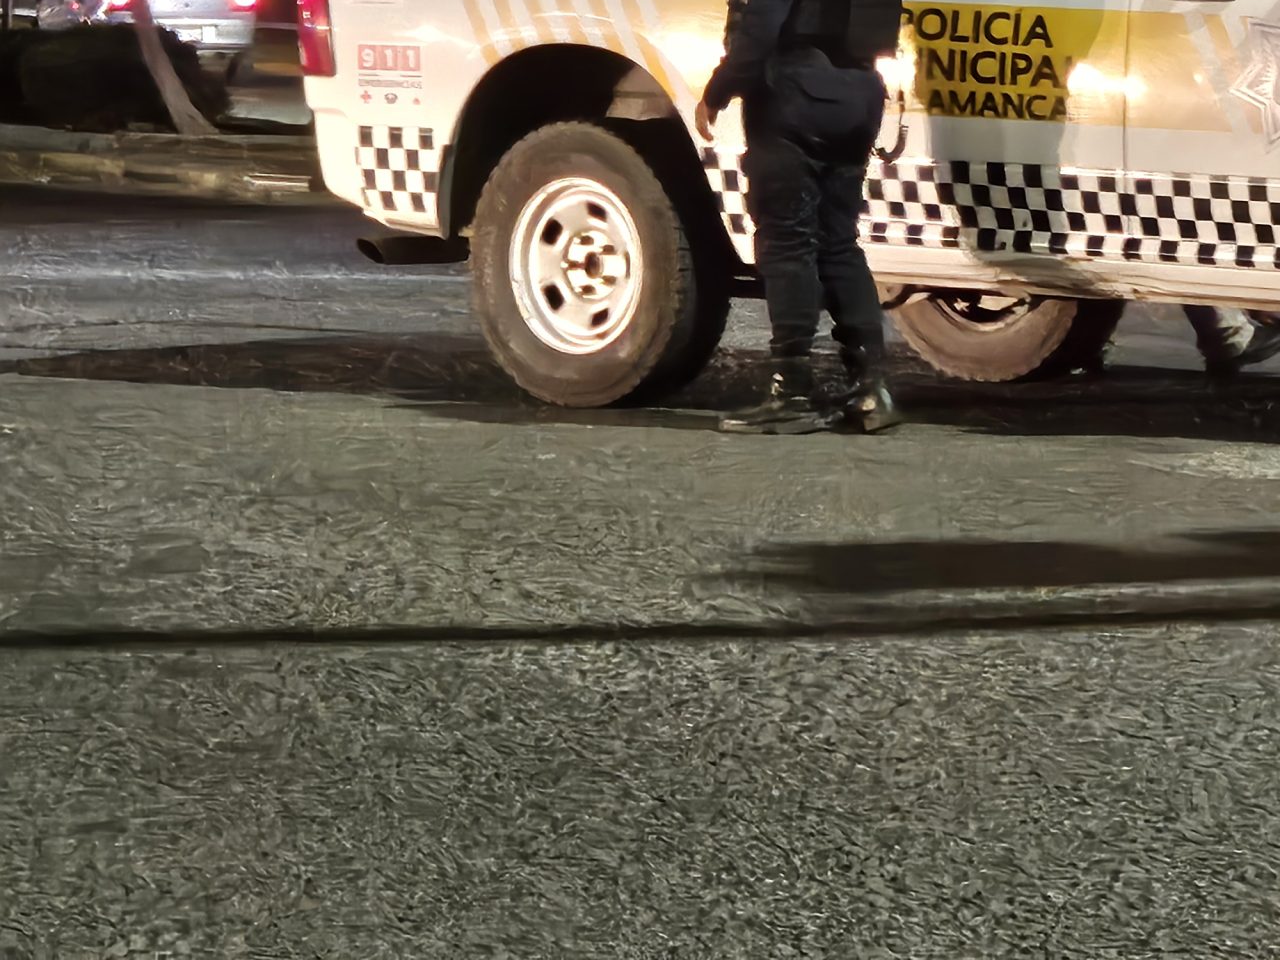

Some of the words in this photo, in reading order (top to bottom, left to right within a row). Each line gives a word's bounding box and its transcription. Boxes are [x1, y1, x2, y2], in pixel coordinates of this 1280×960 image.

[360, 47, 416, 68] 911
[917, 45, 1072, 89] NICIPA
[926, 88, 1068, 121] AMANCA
